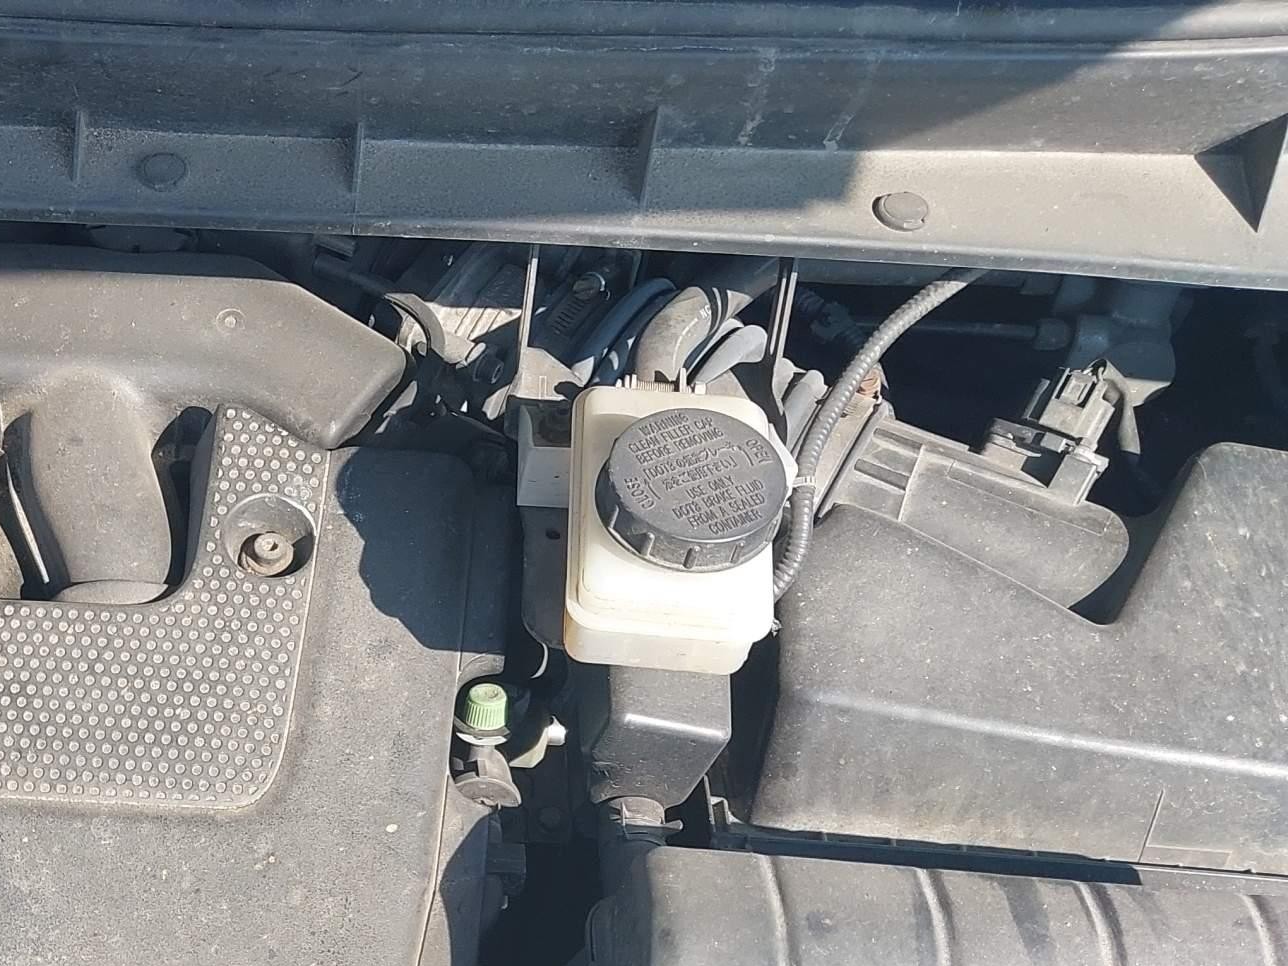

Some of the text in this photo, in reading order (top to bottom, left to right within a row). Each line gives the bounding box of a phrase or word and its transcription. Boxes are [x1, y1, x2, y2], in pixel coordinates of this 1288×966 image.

[628, 416, 713, 454] CLEAN FILLER CAP
[638, 413, 689, 437] WARNING
[635, 426, 725, 465] BEFORE REMOVING
[623, 477, 655, 509] CLOSE
[685, 475, 734, 500] USE ONLY
[702, 488, 736, 509] BRAKE
[735, 479, 764, 497] FLUID
[687, 493, 765, 529] FROM A SEALED
[708, 509, 763, 536] CONTAINER
